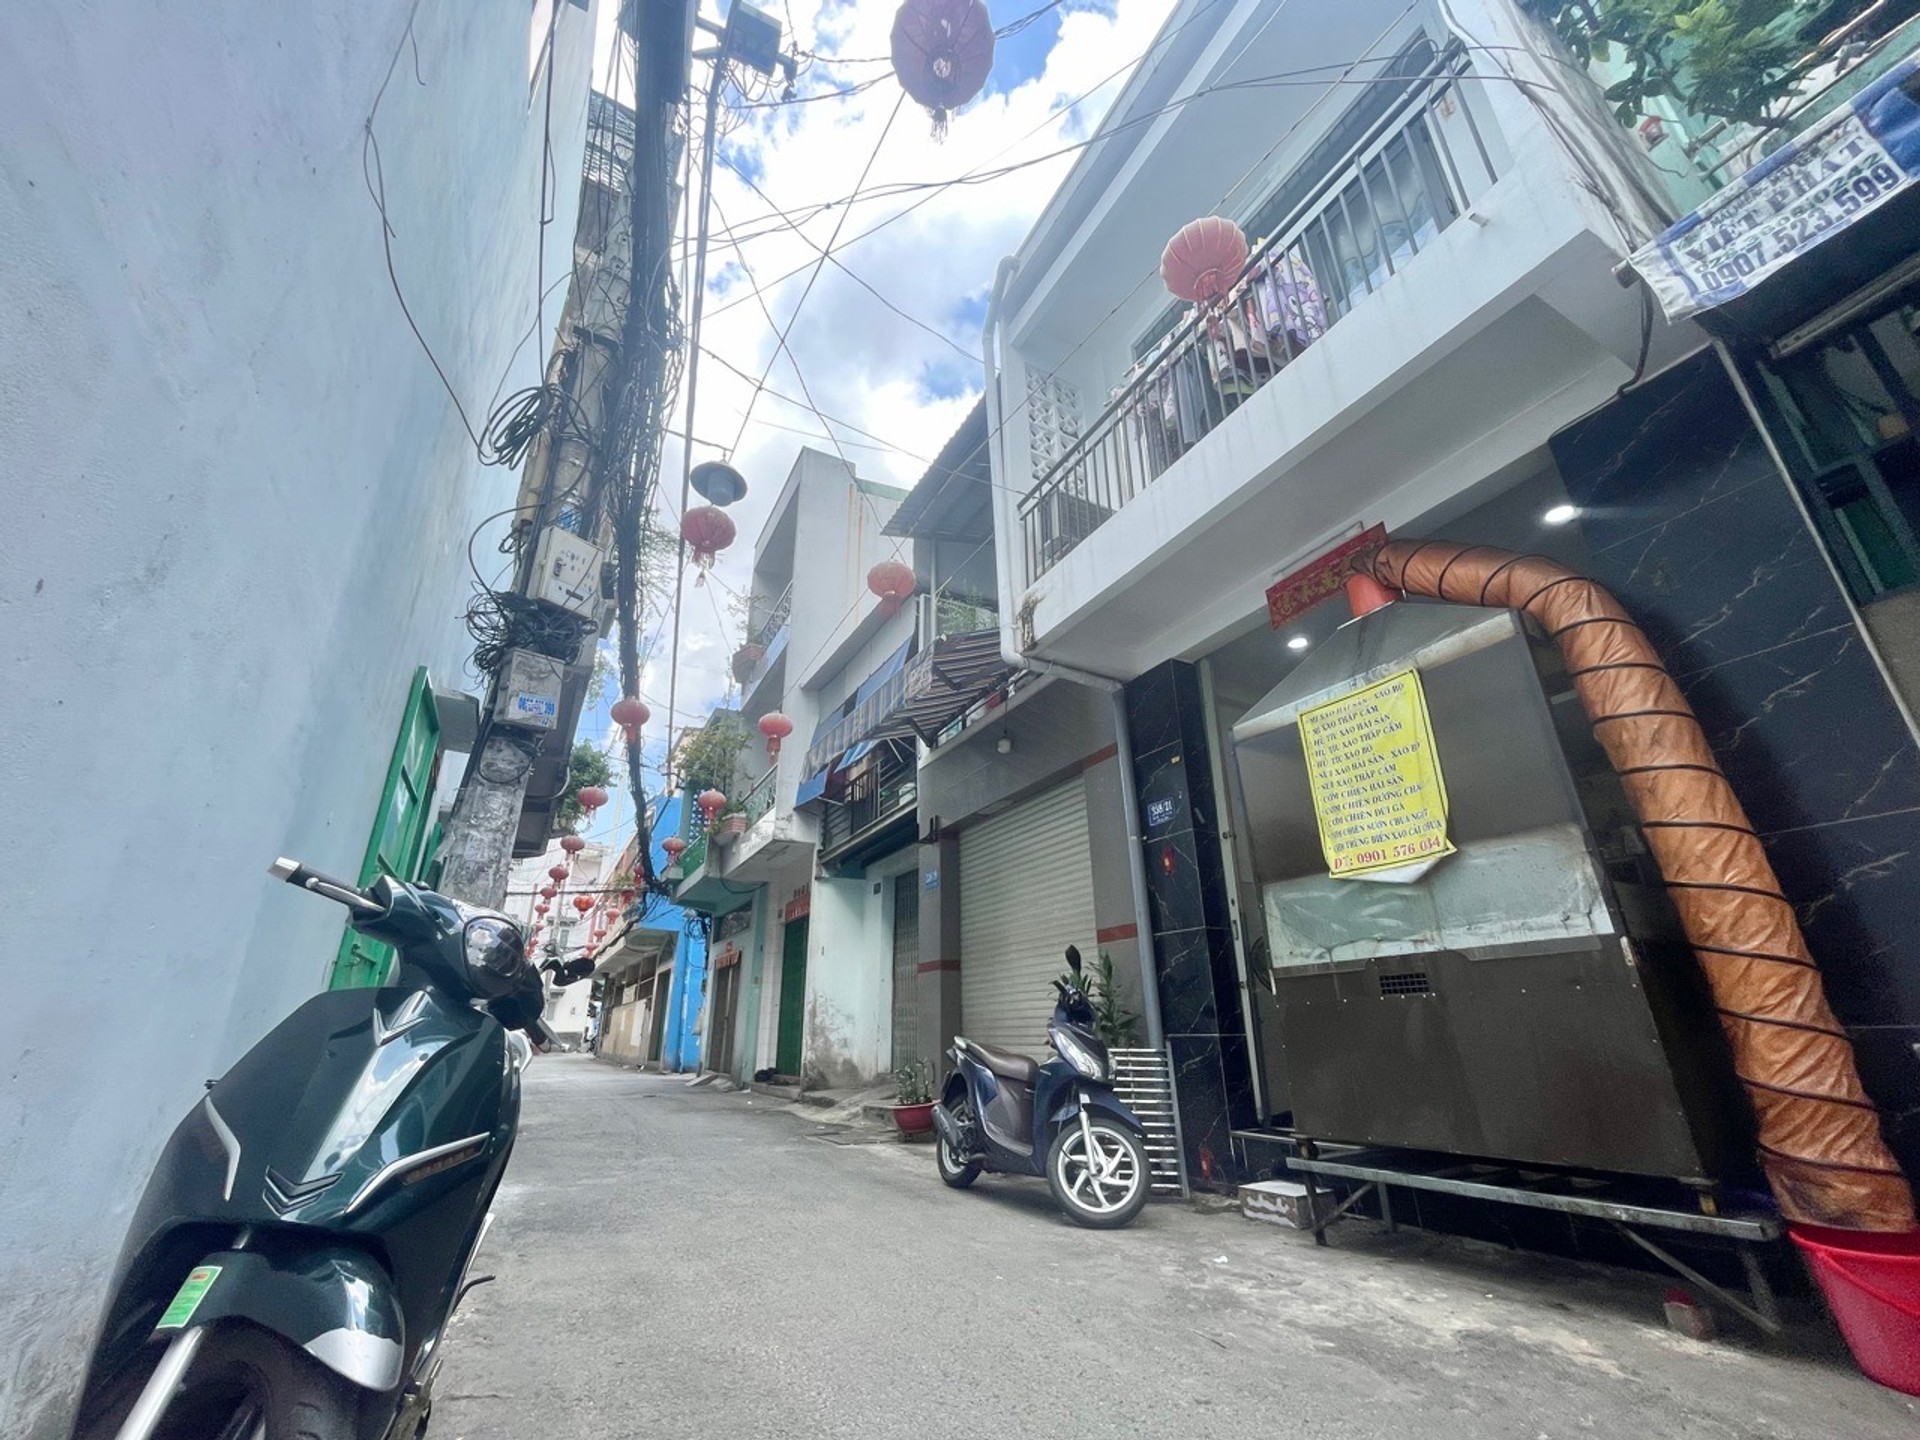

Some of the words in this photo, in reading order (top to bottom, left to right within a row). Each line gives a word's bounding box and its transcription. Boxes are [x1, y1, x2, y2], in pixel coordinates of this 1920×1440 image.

[1701, 163, 1900, 291] 0907.523.599
[1357, 848, 1387, 865] 0901
[1393, 843, 1415, 858] 576
